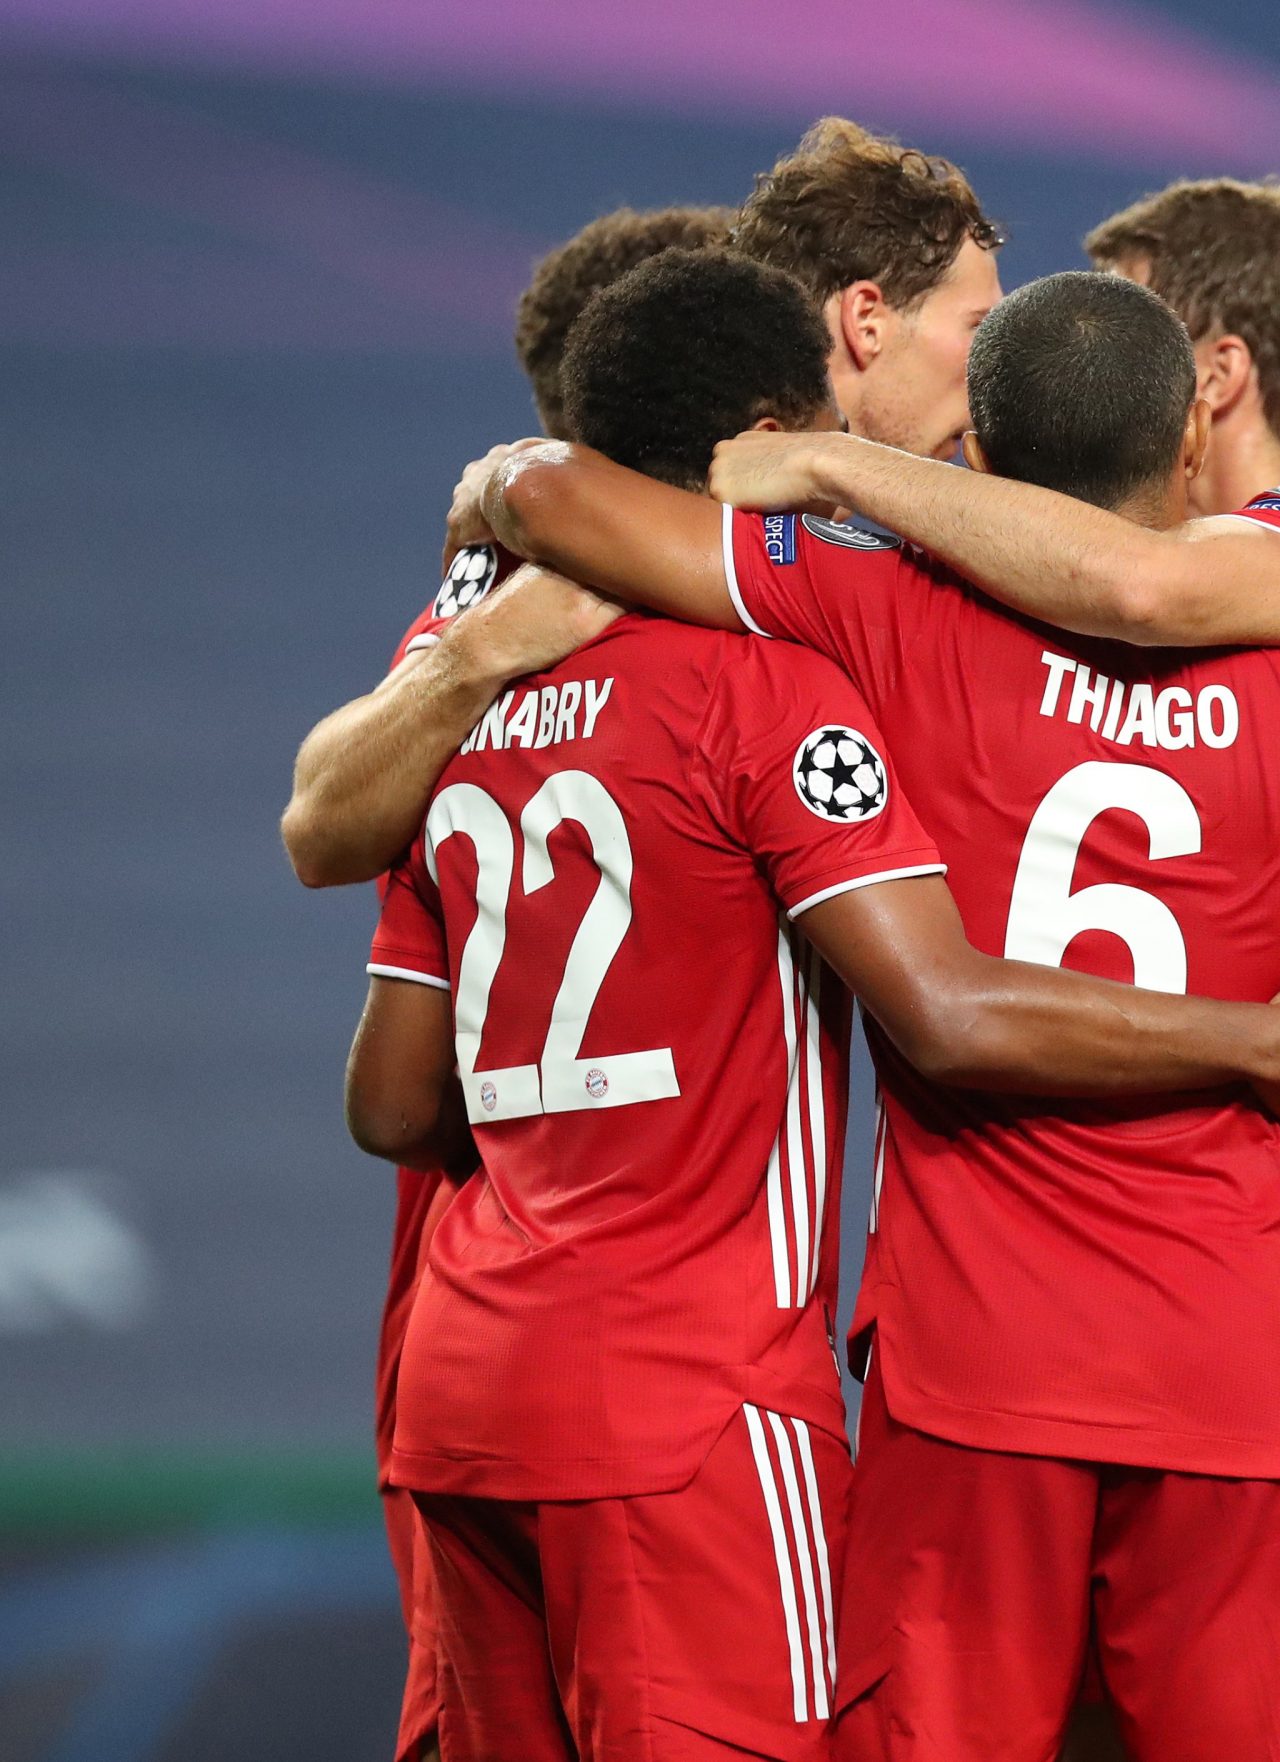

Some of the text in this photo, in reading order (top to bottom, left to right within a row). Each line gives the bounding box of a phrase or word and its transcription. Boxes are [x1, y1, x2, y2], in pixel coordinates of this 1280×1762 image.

[1039, 650, 1240, 750] THIAGO
[425, 769, 681, 1124] 22
[1004, 760, 1202, 995] 6
